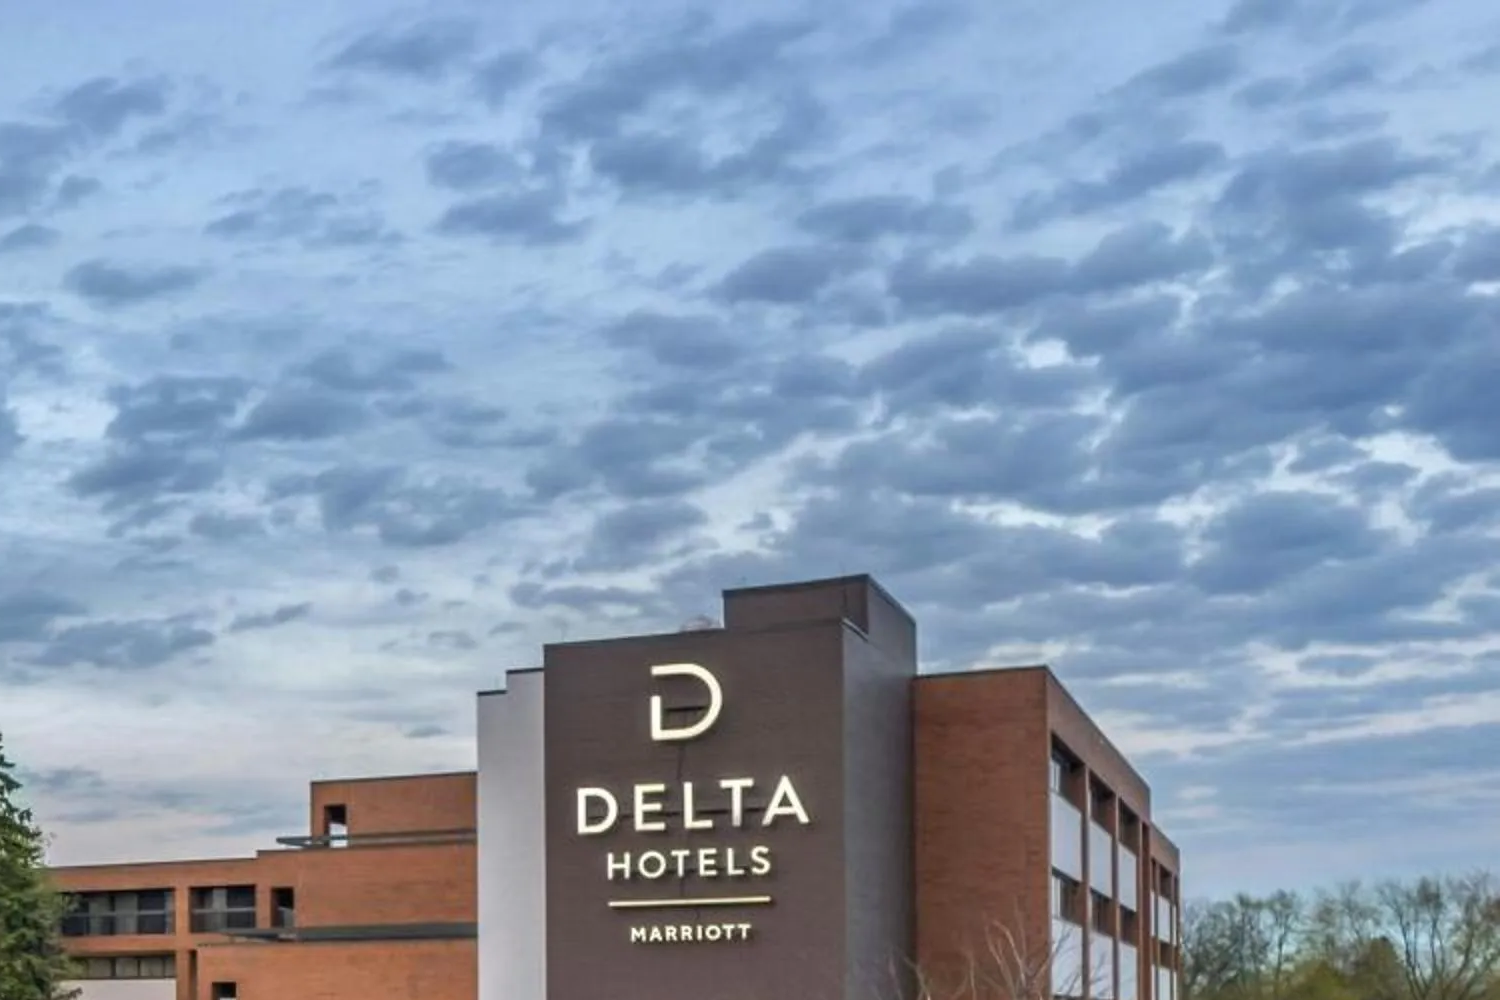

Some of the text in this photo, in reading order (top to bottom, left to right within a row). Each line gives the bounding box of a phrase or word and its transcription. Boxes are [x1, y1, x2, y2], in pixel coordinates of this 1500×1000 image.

[650, 663, 723, 741] D
[576, 774, 810, 835] DELTA
[606, 845, 771, 881] HOTELS
[630, 922, 752, 943] MARRIOTT
